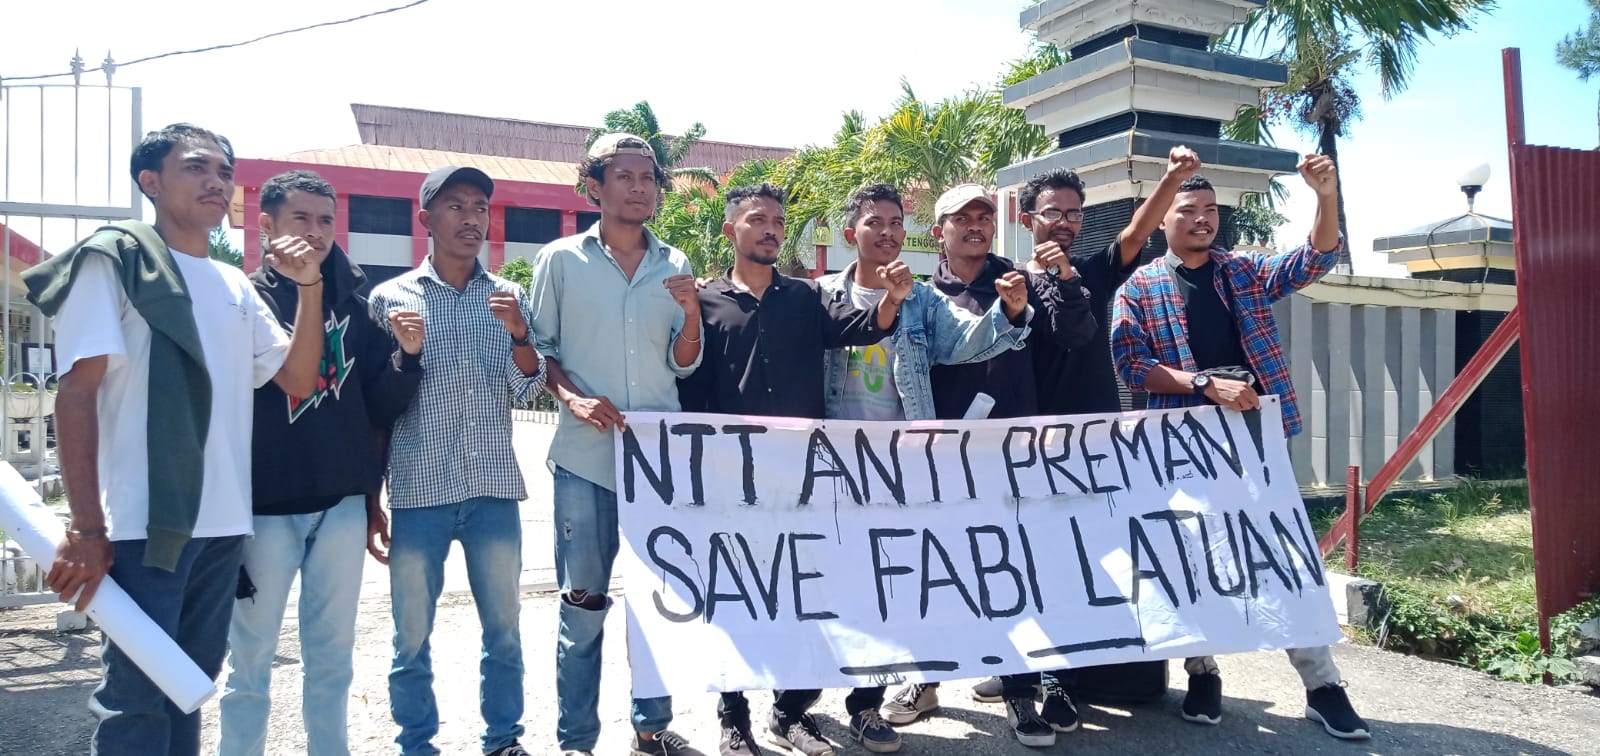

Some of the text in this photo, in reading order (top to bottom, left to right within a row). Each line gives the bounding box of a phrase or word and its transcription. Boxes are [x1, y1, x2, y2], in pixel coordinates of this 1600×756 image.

[906, 236, 940, 249] TENGG
[623, 406, 1270, 506] NTT ANTI PREMAN!
[647, 507, 1325, 623] SAVE FABI LATUAN
